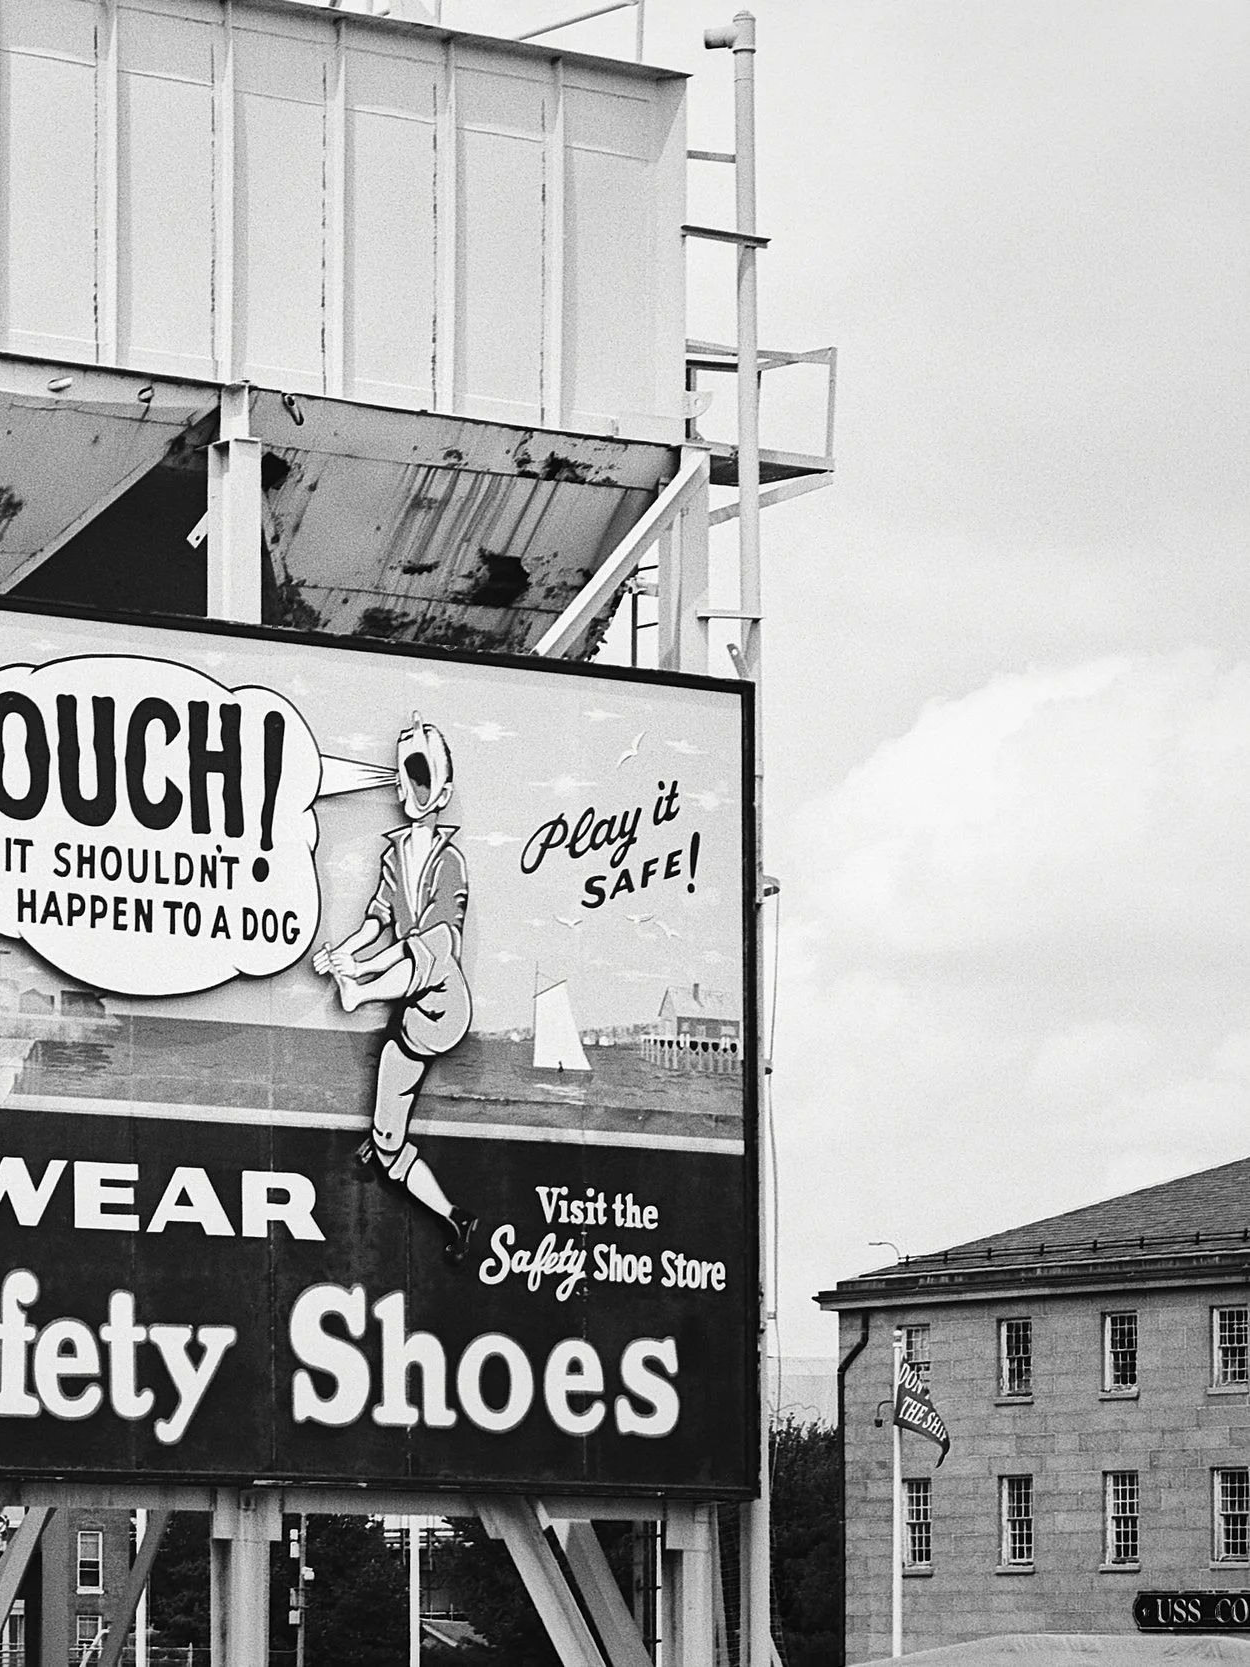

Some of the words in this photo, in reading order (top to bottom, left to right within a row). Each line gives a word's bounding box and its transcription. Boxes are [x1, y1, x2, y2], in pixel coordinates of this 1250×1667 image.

[520, 807, 642, 869] Play
[652, 780, 680, 826] it
[5, 838, 34, 874] IT
[53, 843, 240, 890] SHOULDN'T
[580, 832, 701, 909] SAFE!
[17, 889, 153, 933] HAPPEN
[162, 901, 202, 937] TO
[210, 906, 231, 940] A
[242, 907, 301, 945] DOG
[535, 1186, 608, 1225] Visit
[612, 1193, 659, 1230] the
[478, 1224, 588, 1302] Safety
[593, 1243, 653, 1285] Shoe
[660, 1250, 727, 1291] Store
[288, 1285, 680, 1437] Shoes
[899, 1395, 929, 1425] THE
[1156, 1598, 1202, 1624] USS
